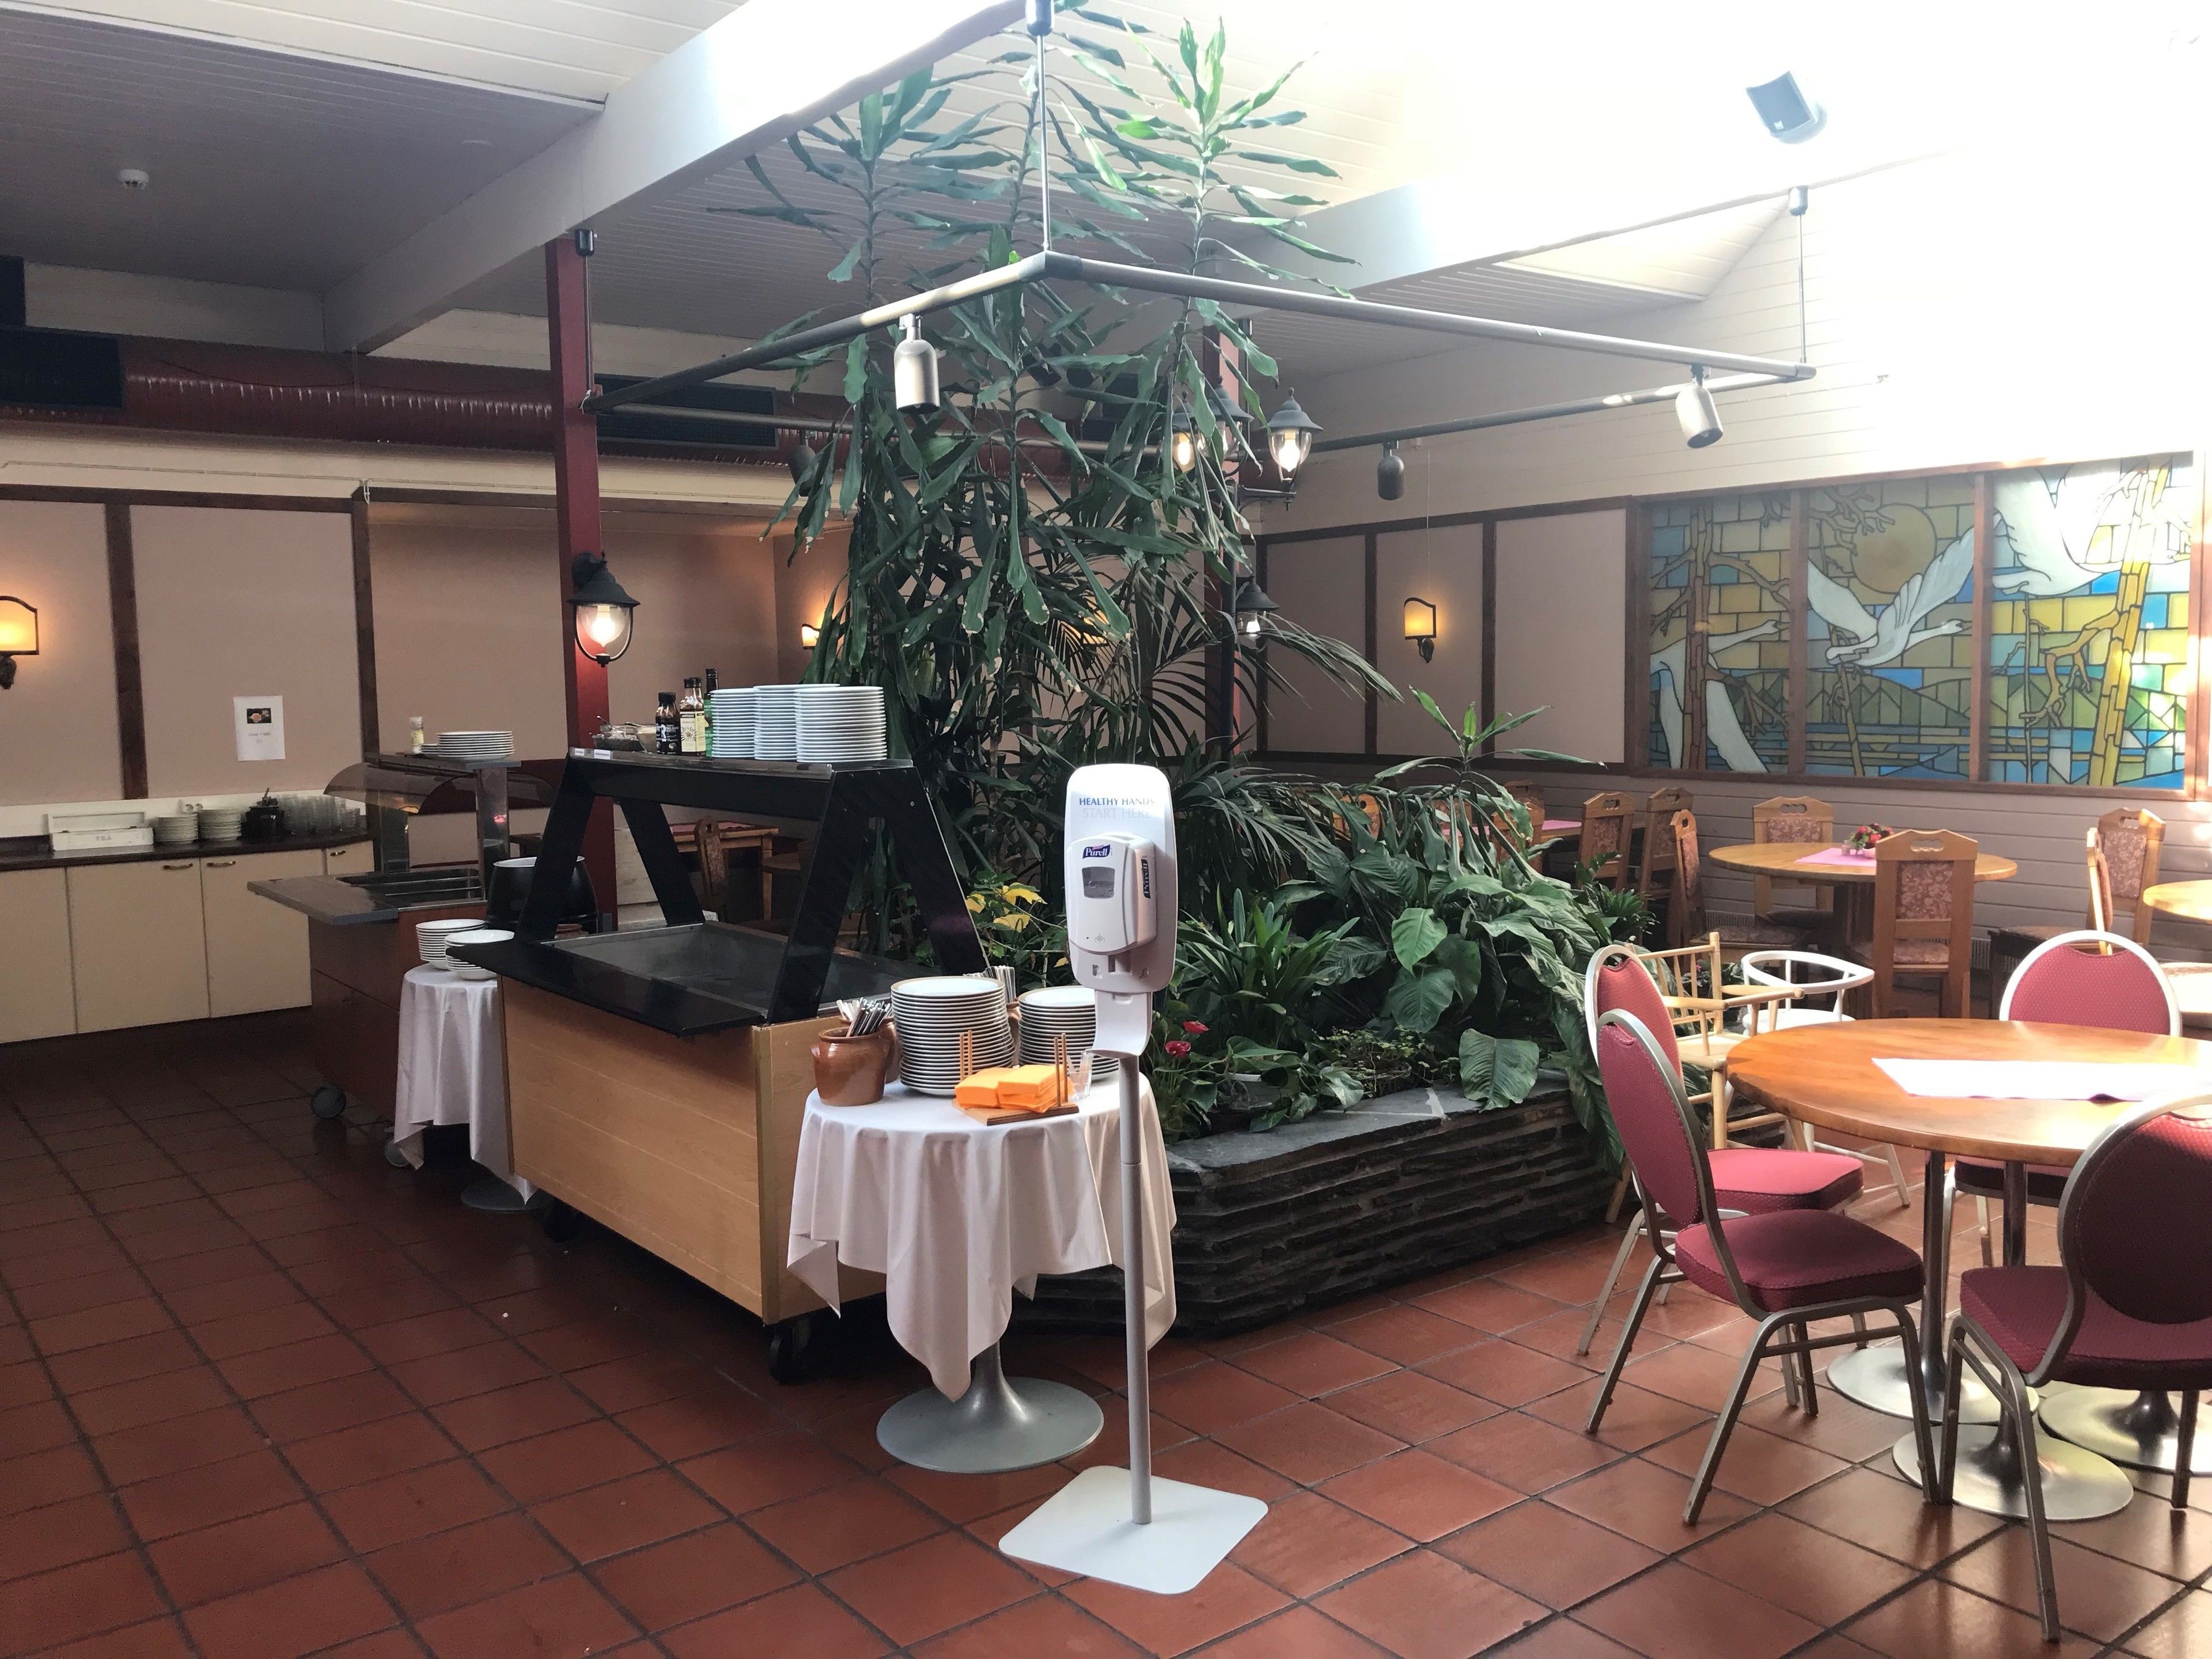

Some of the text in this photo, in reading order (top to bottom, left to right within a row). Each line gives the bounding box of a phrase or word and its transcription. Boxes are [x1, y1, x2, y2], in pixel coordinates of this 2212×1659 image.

[1082, 808, 1152, 818] START HERE
[1085, 847, 1108, 857] Purell
